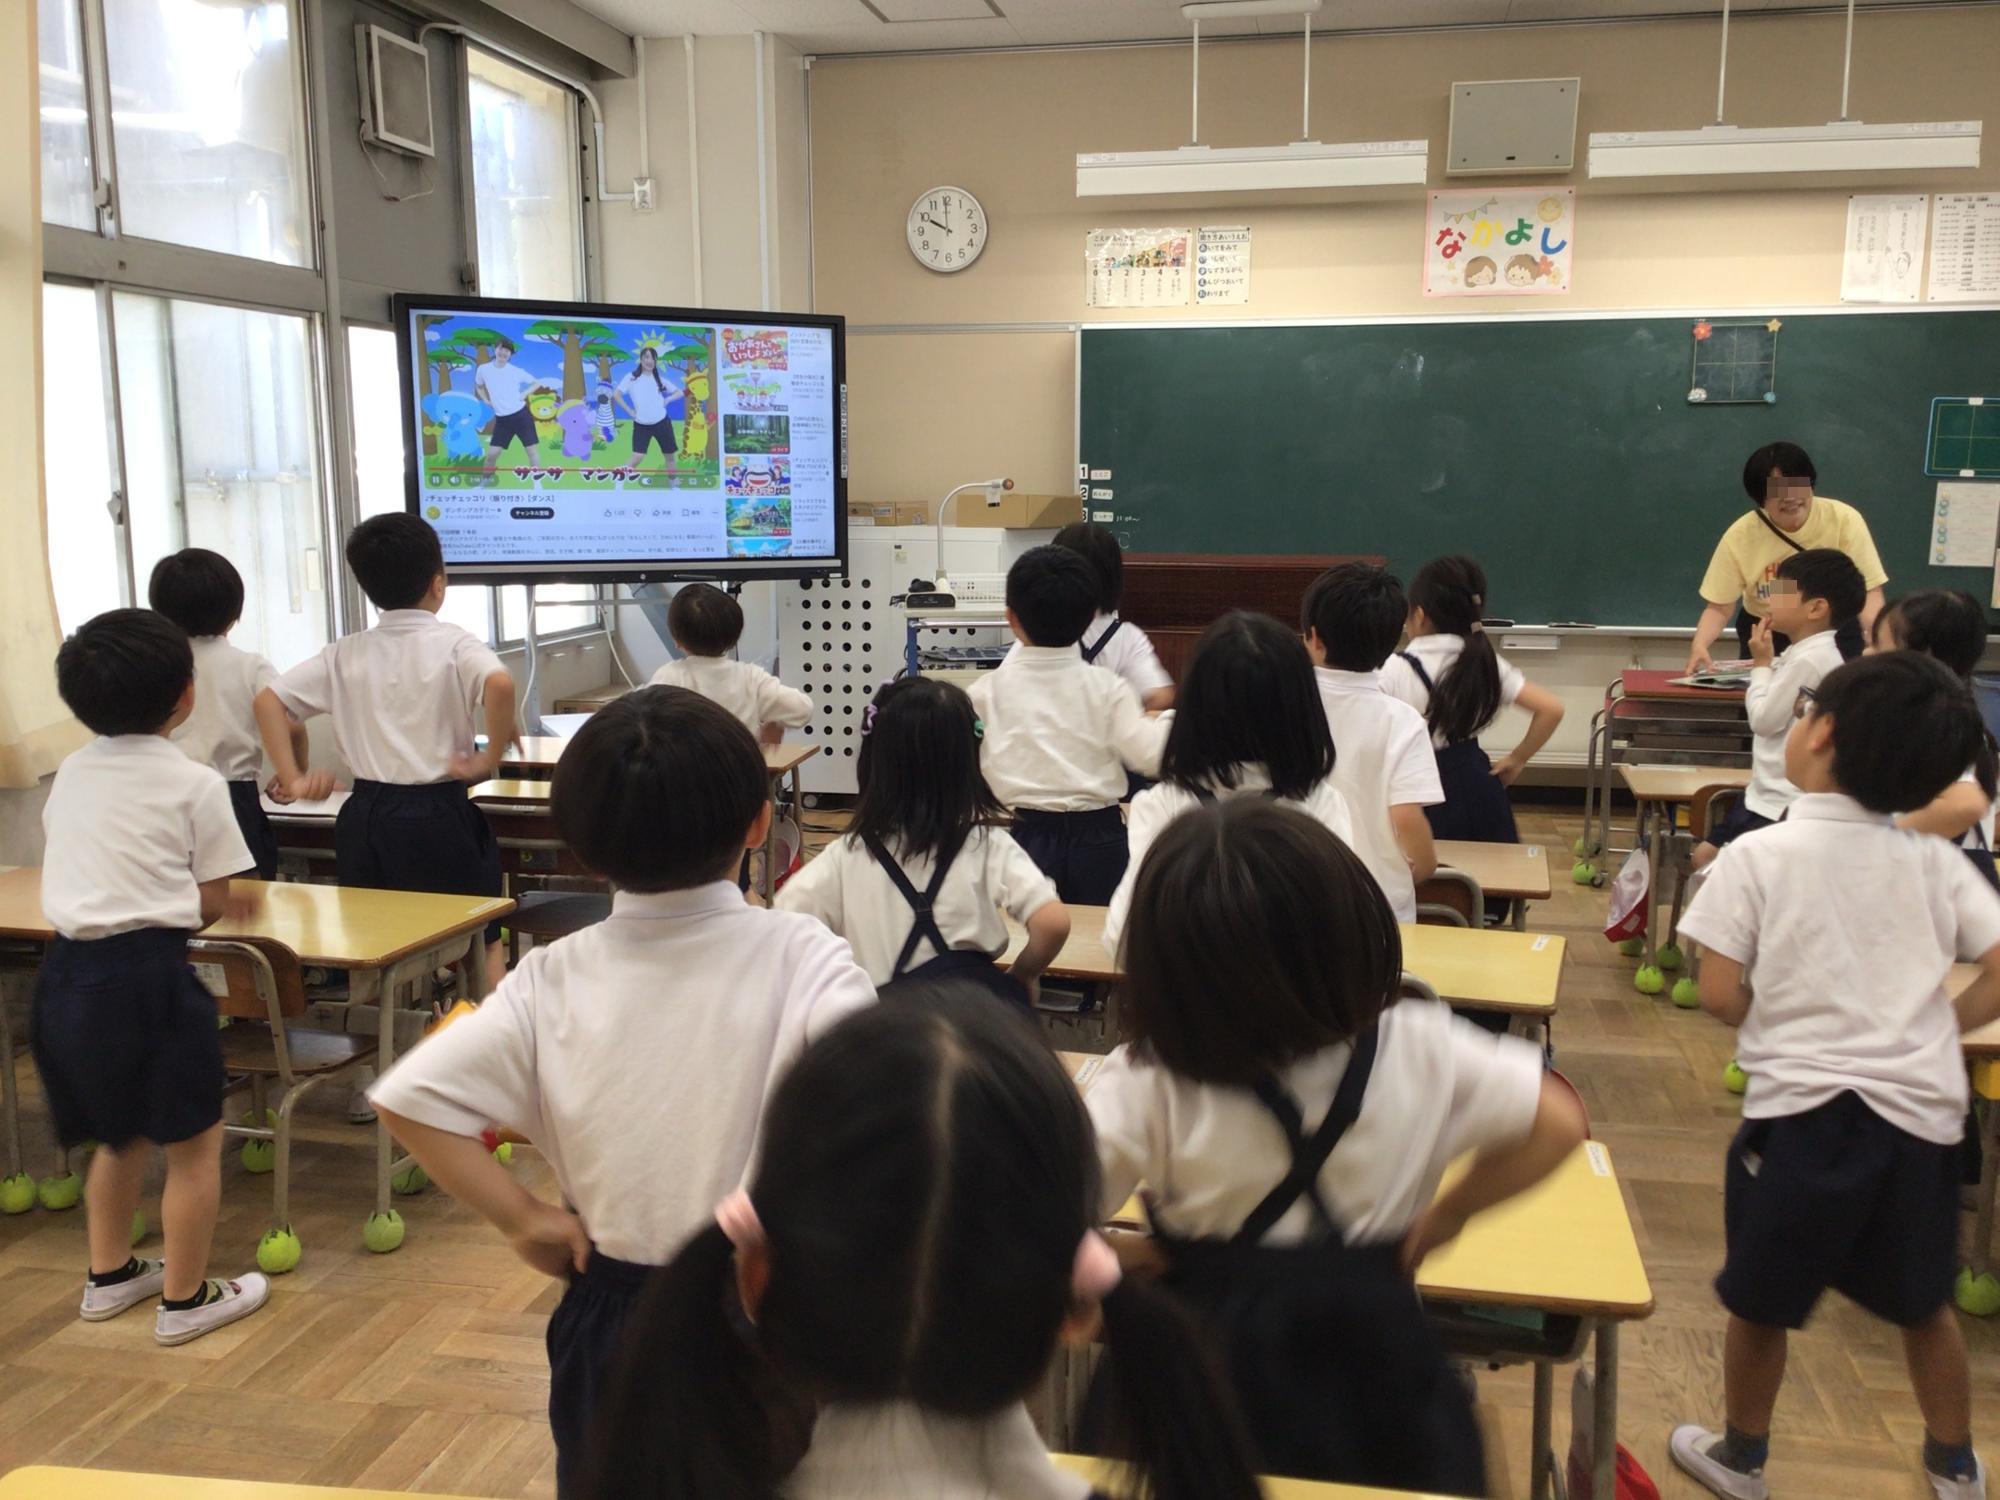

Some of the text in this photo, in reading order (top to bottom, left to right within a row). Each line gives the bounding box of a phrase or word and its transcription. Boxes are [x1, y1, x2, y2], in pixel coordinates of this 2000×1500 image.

[929, 200, 937, 211] 11
[942, 195, 952, 206] 12
[920, 211, 930, 222] 10
[966, 208, 973, 219] 2
[917, 226, 925, 236] 9
[970, 223, 978, 233] 3
[1200, 231, 1248, 241] 聞き方あいうえお
[1436, 218, 1567, 259] なかよし
[922, 240, 929, 250] 8
[967, 238, 974, 248] 4
[932, 249, 939, 259] 7
[945, 252, 952, 263] 6
[958, 248, 965, 258] 5
[514, 464, 641, 481] サンサ マンガン
[1081, 466, 1086, 478] 1
[1080, 487, 1087, 498] 2
[1082, 510, 1087, 520] 3
